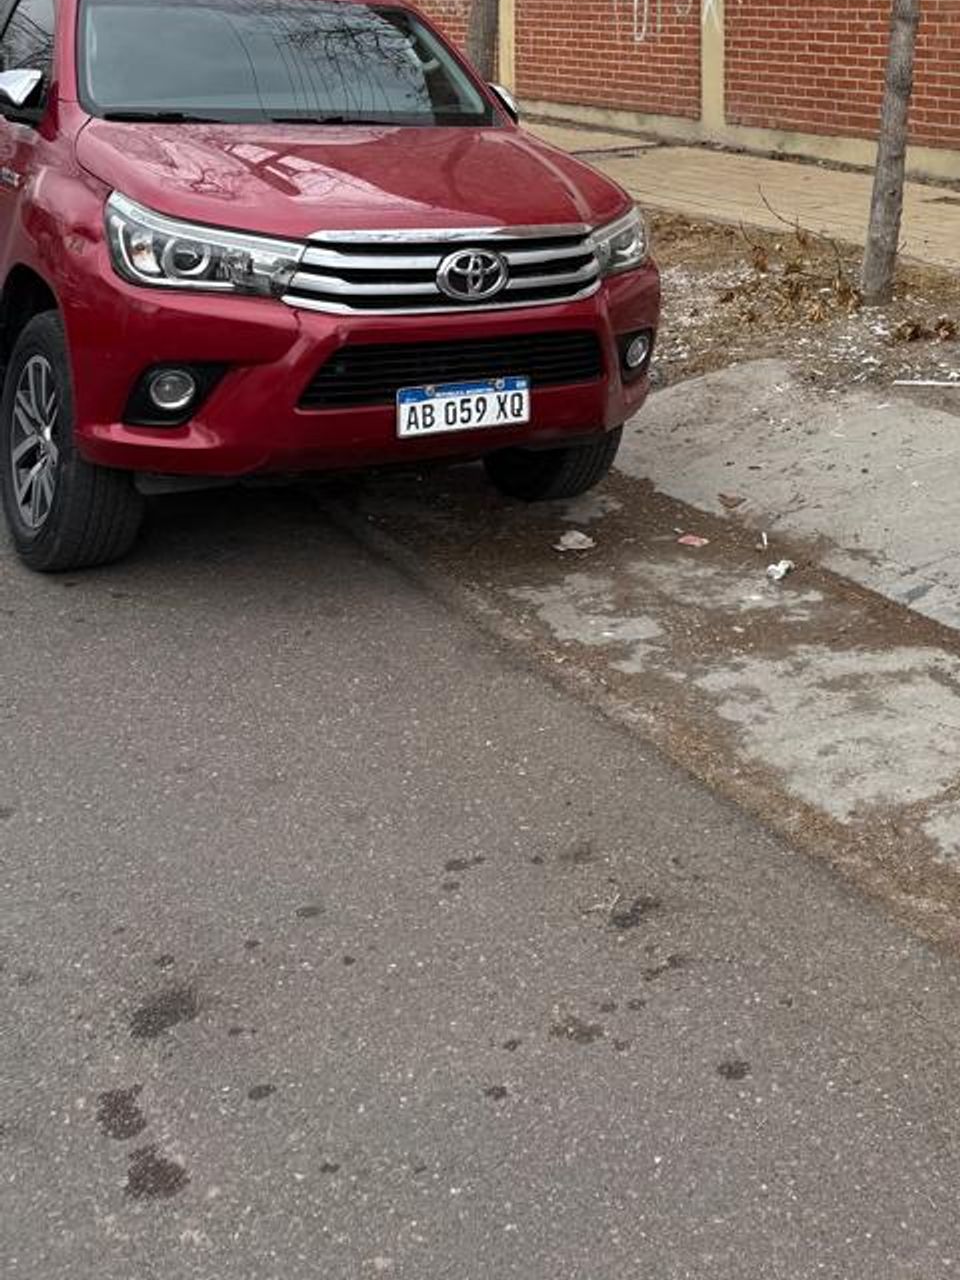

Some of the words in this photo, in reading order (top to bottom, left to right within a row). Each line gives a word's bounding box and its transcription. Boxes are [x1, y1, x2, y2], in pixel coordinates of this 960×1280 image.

[406, 404, 435, 431] AB
[444, 395, 487, 425] 059
[496, 392, 524, 420] XQ
